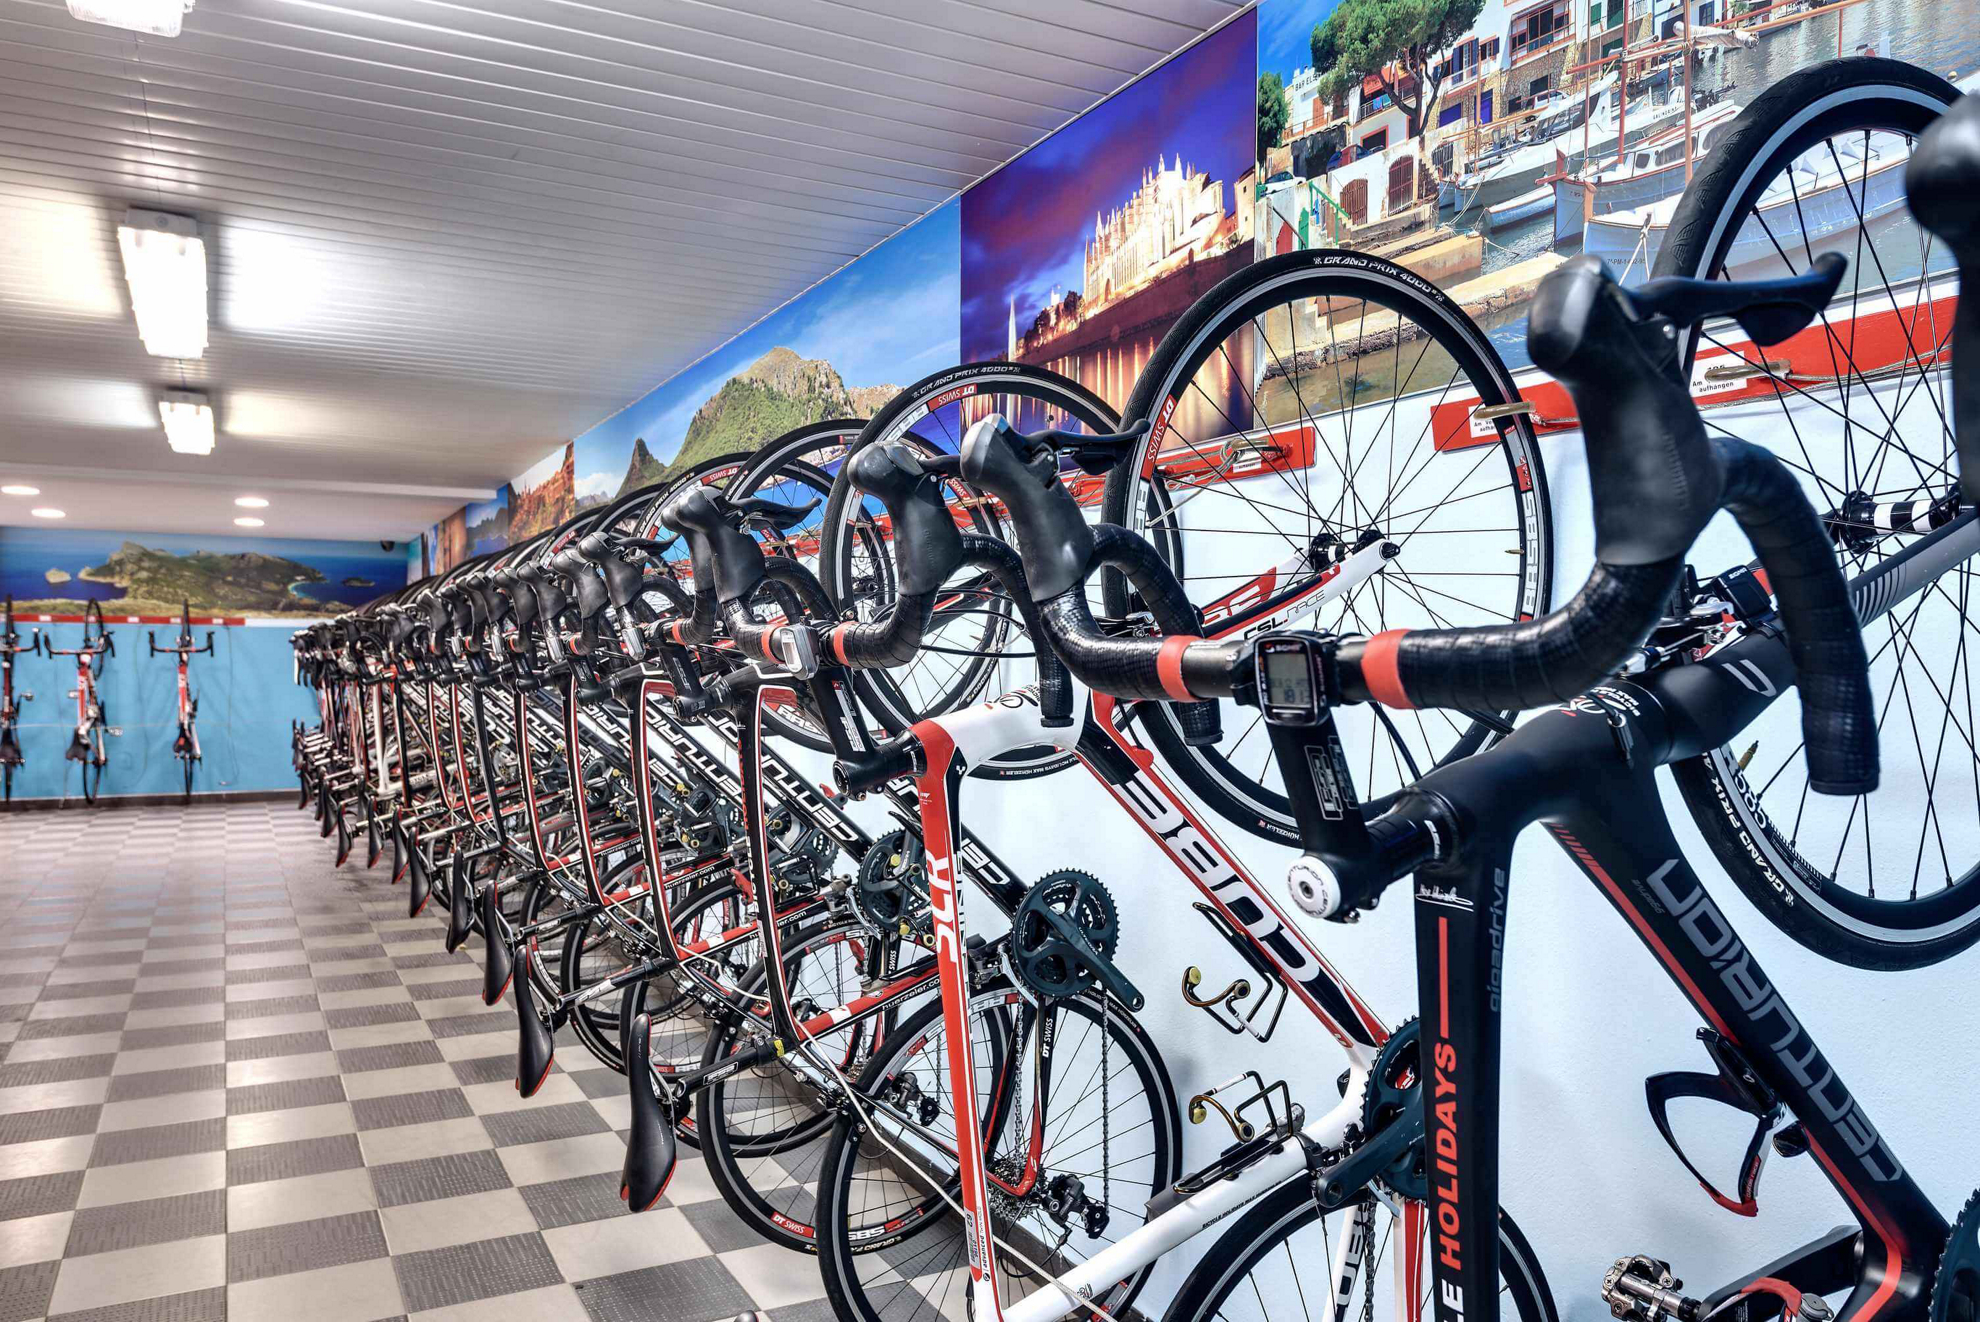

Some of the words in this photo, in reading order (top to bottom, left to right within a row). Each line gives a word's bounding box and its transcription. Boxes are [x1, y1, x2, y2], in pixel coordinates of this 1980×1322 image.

[1323, 256, 1367, 267] GRAND
[1369, 261, 1398, 276] PRIX
[920, 374, 953, 395] GRAND
[954, 367, 979, 380] PRIX
[938, 390, 961, 406] SWISS
[962, 385, 976, 396] DT
[1162, 398, 1175, 424] DT
[1147, 421, 1165, 463] SWISS
[1711, 776, 1741, 829] PRIX
[1110, 765, 1320, 983] CUBE
[1739, 830, 1785, 893] GRAND
[1489, 867, 1506, 1013] gigadrive
[882, 976, 939, 1010] huerzeler.co
[1043, 1018, 1053, 1042] SWISS
[1646, 857, 1902, 1182] CENTURION
[1042, 1043, 1050, 1058] DT
[1434, 1042, 1462, 1271] HOLIDAYS
[773, 1215, 784, 1225] DT
[784, 1219, 805, 1234] SWISS
[980, 1235, 988, 1269] advanced
